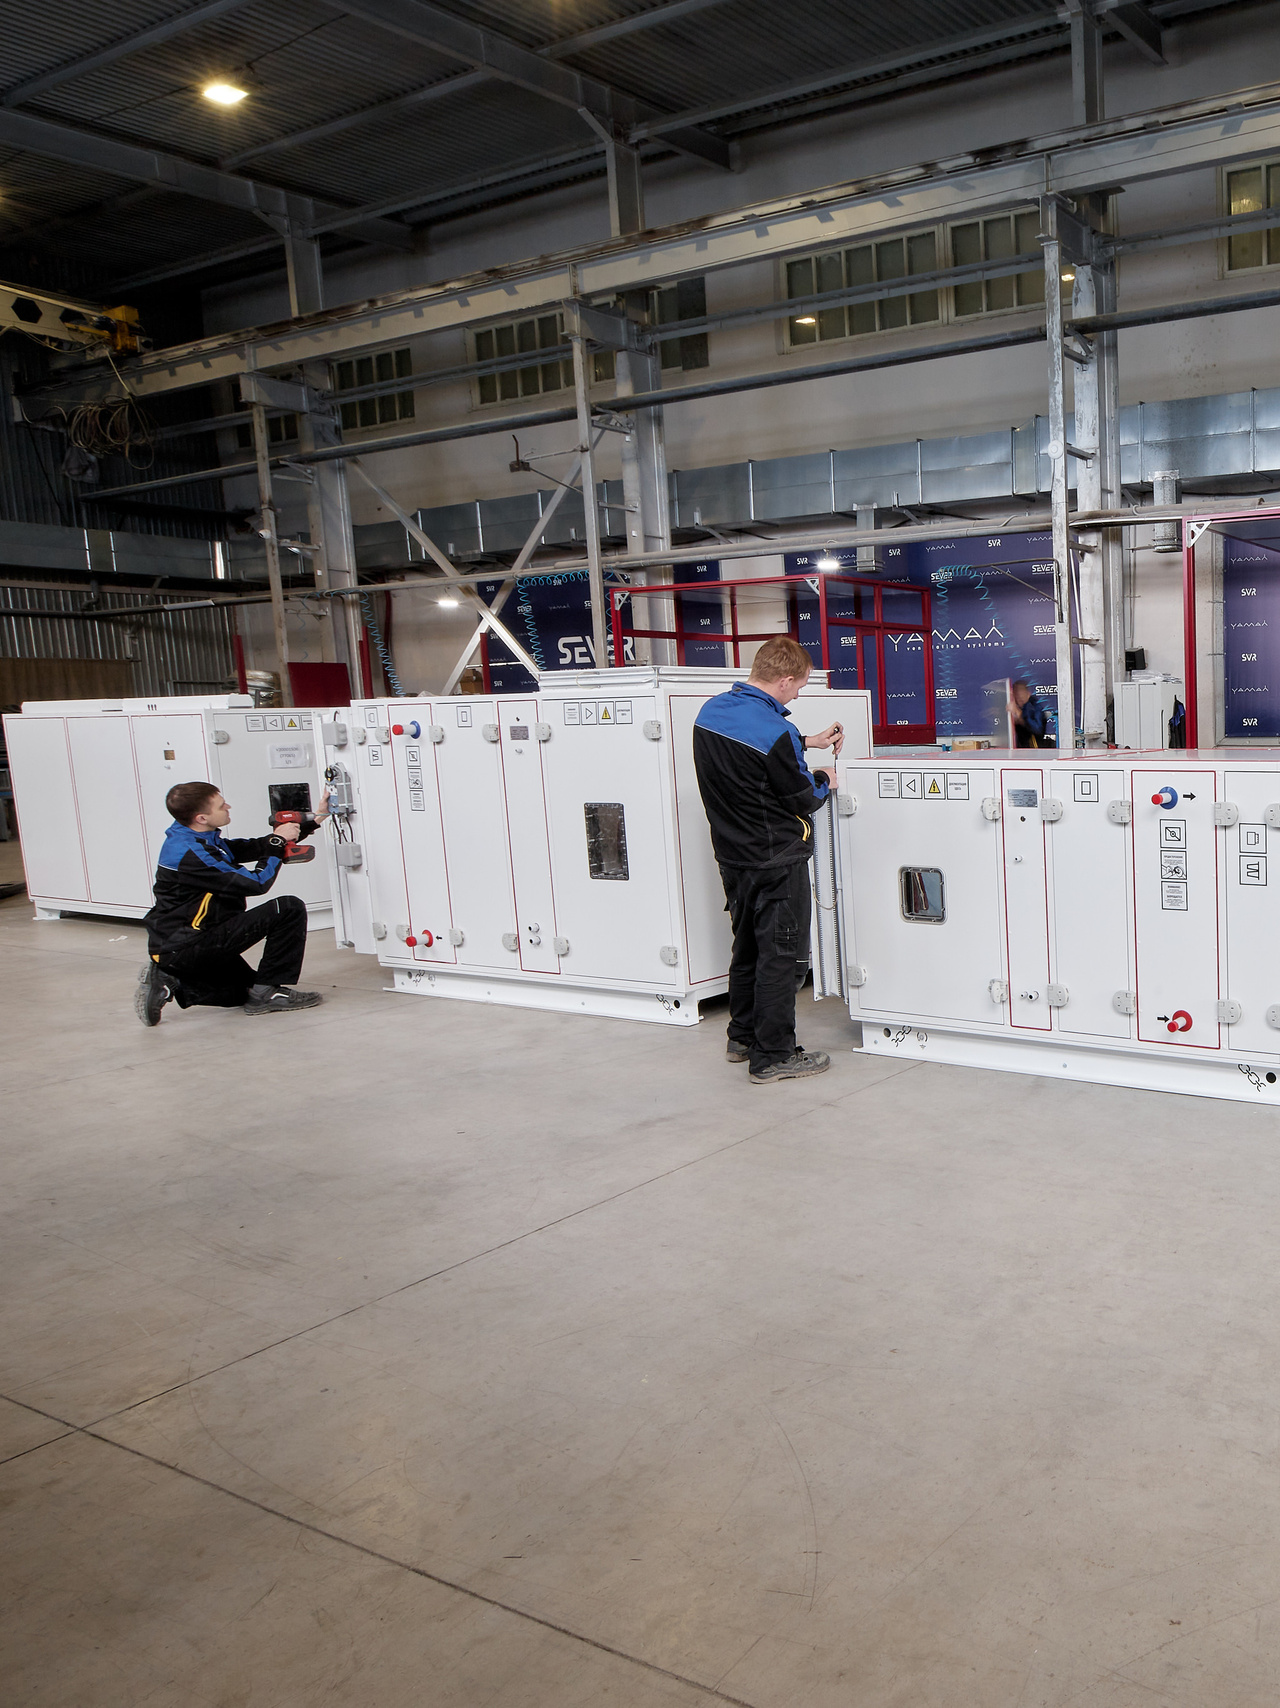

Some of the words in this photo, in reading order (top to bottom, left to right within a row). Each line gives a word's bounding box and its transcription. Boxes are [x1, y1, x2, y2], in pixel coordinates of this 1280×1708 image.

[988, 539, 1001, 547] SVR
[889, 548, 901, 556] SVR
[797, 557, 808, 565] SVR
[1241, 588, 1257, 597] SVR
[1241, 653, 1257, 662] SVR
[936, 689, 957, 697] SEVER
[1242, 718, 1258, 726] SVR
